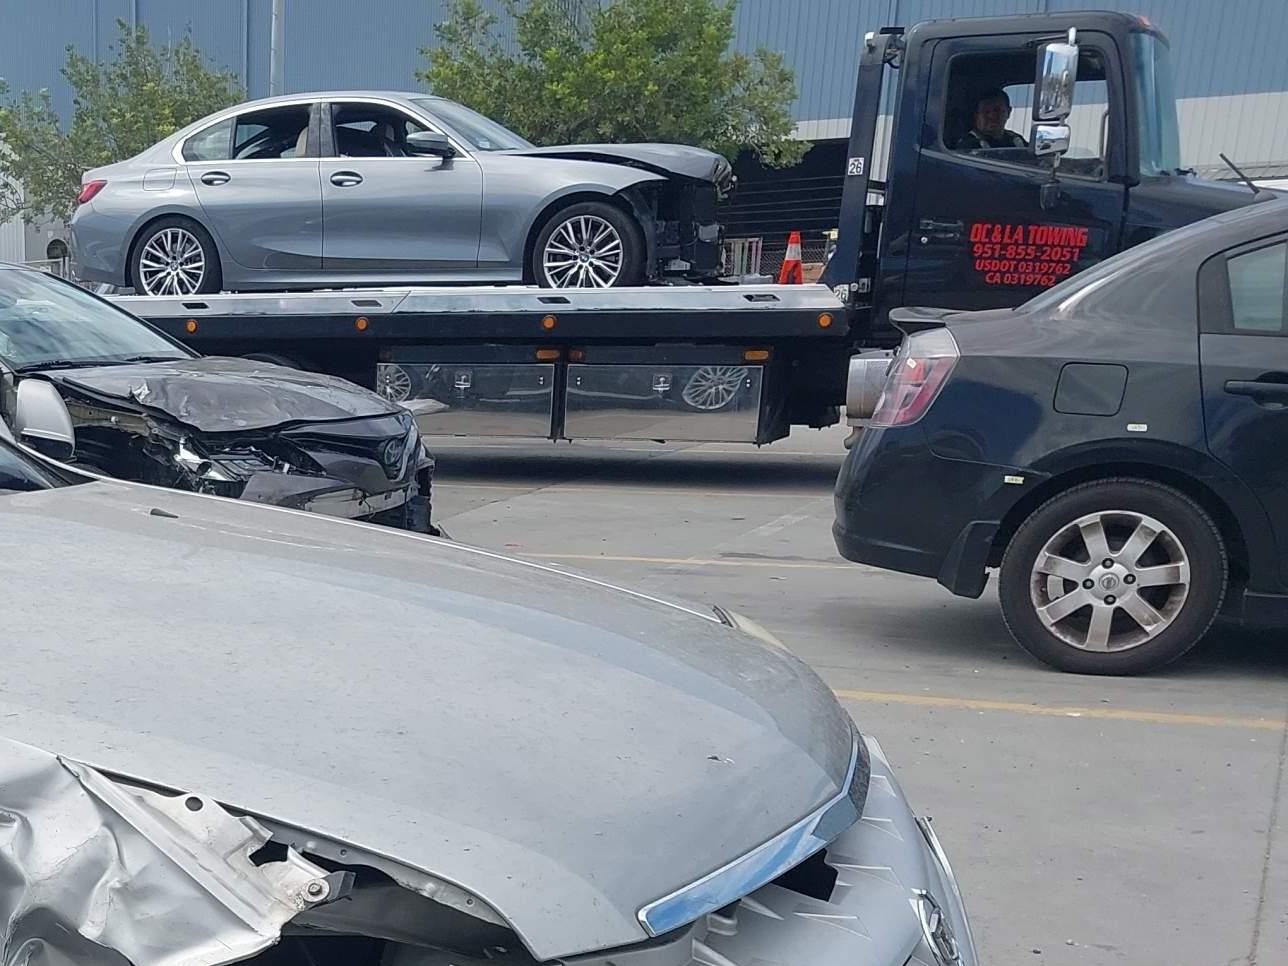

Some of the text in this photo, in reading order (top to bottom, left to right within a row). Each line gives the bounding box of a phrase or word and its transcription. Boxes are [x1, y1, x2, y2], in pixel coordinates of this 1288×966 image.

[849, 161, 863, 175] 26
[1027, 225, 1089, 247] TOWING
[973, 244, 1081, 262] 951-855-2051
[975, 259, 1072, 275] USDOT 0319762
[985, 272, 1057, 287] CA 0319762
